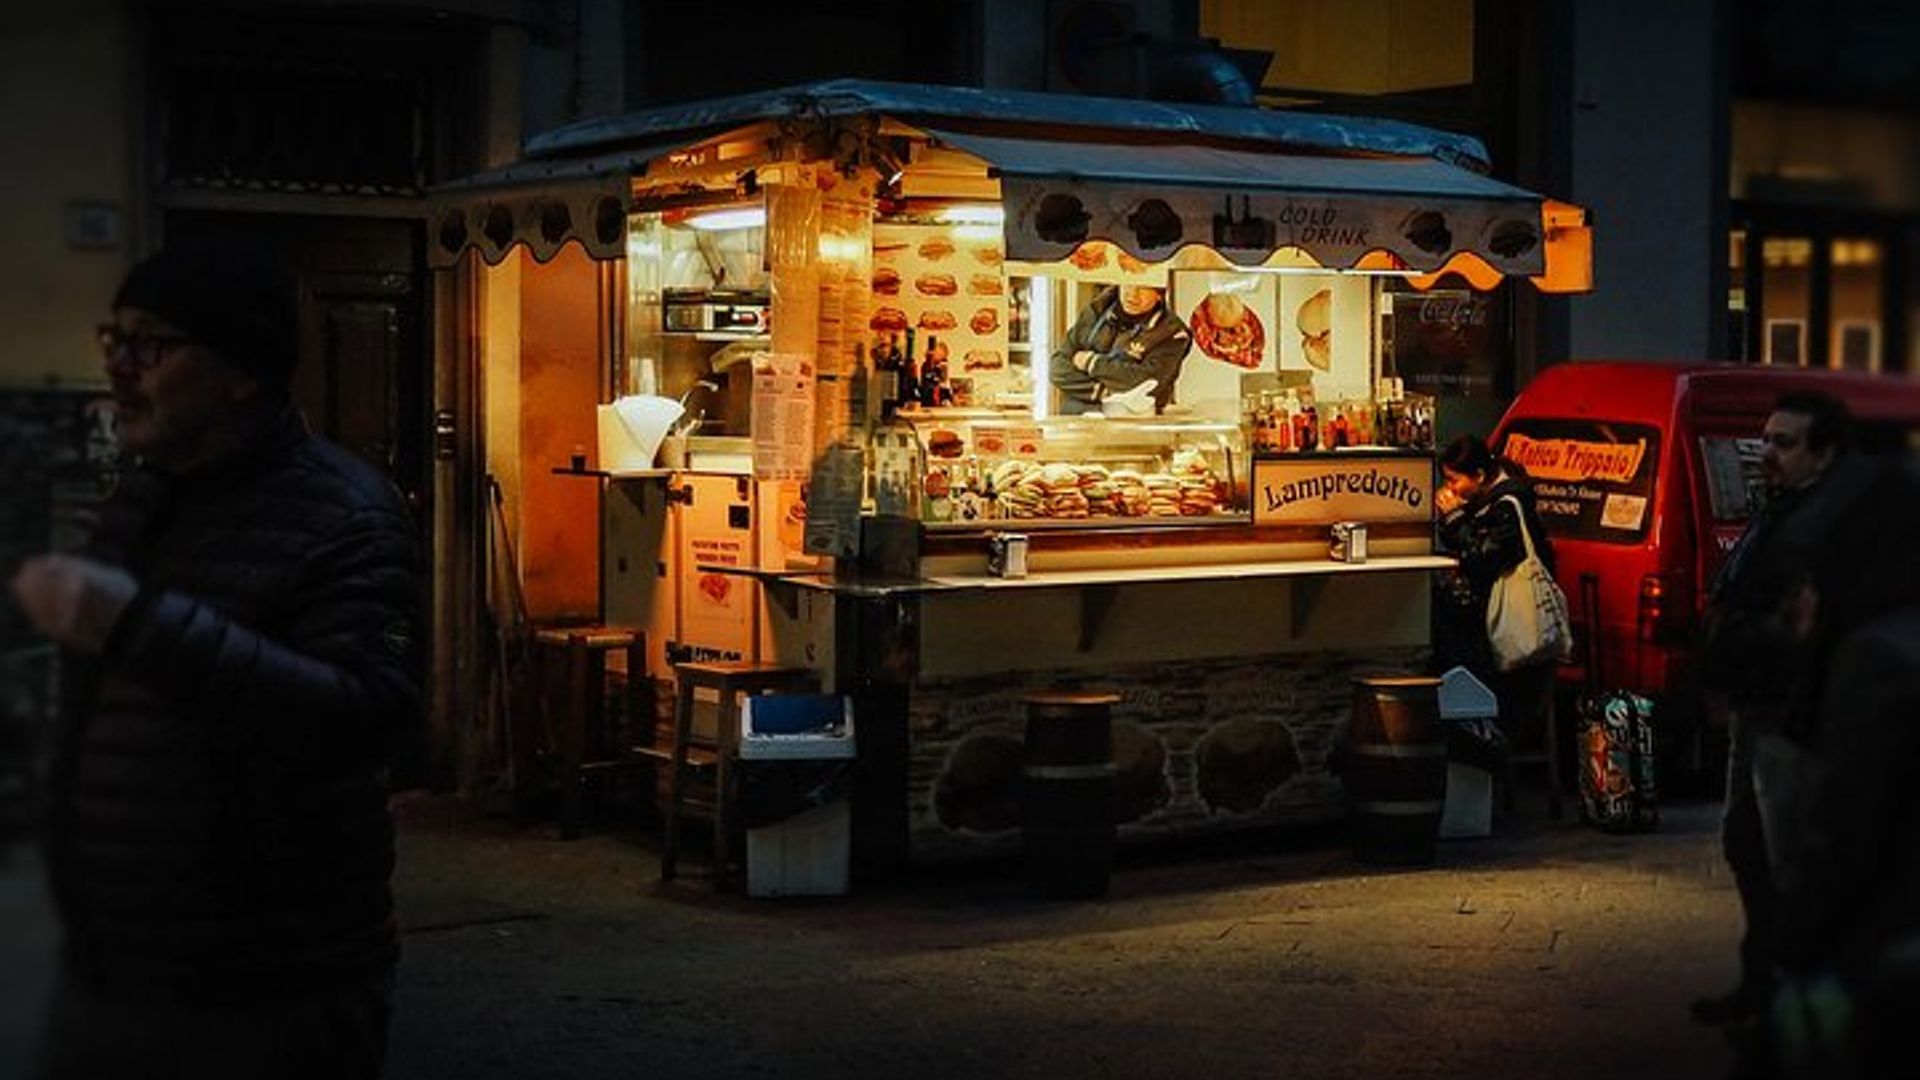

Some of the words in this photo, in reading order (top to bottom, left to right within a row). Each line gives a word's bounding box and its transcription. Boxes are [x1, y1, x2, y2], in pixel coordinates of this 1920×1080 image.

[1280, 207, 1337, 226] COLD
[1302, 227, 1368, 246] DRINK
[1263, 468, 1422, 511] Lampredotto
